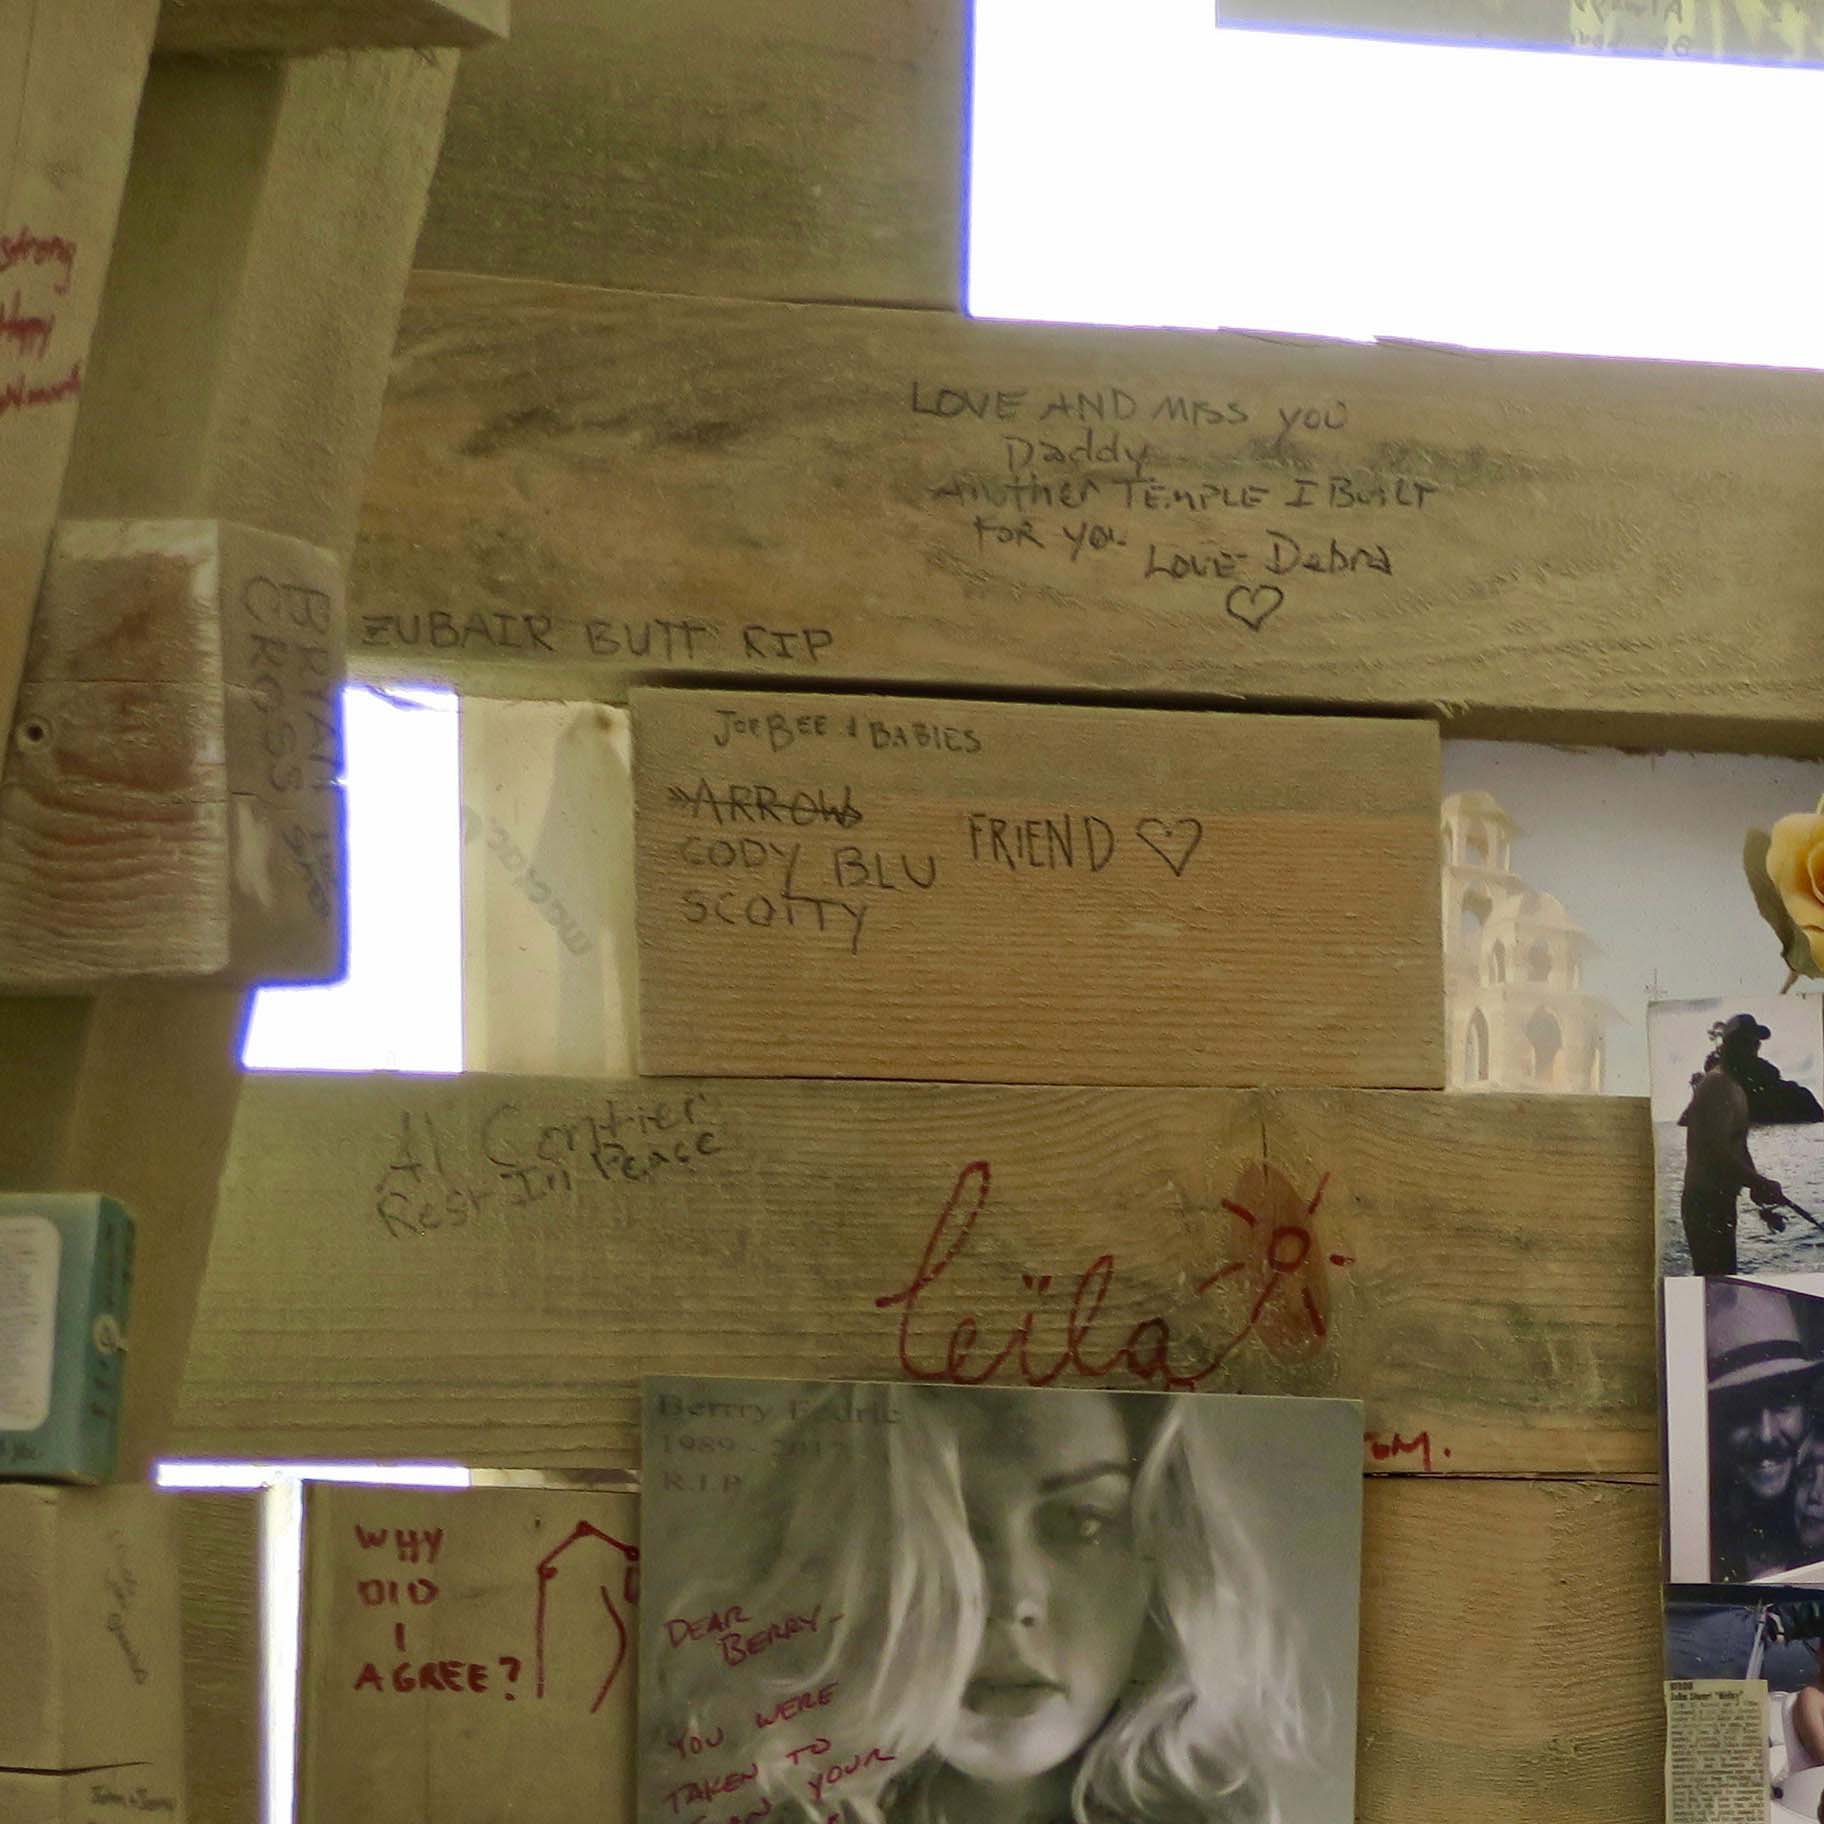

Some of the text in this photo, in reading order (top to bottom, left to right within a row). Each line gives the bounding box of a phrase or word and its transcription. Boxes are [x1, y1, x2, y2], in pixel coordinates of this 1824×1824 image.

[911, 382, 1029, 418] LOVE
[1040, 384, 1138, 423] AND
[832, 844, 937, 891] BLU
[967, 812, 1117, 875] FRIEND
[356, 1522, 444, 1564] WHY
[352, 1653, 524, 1703] AGREE?
